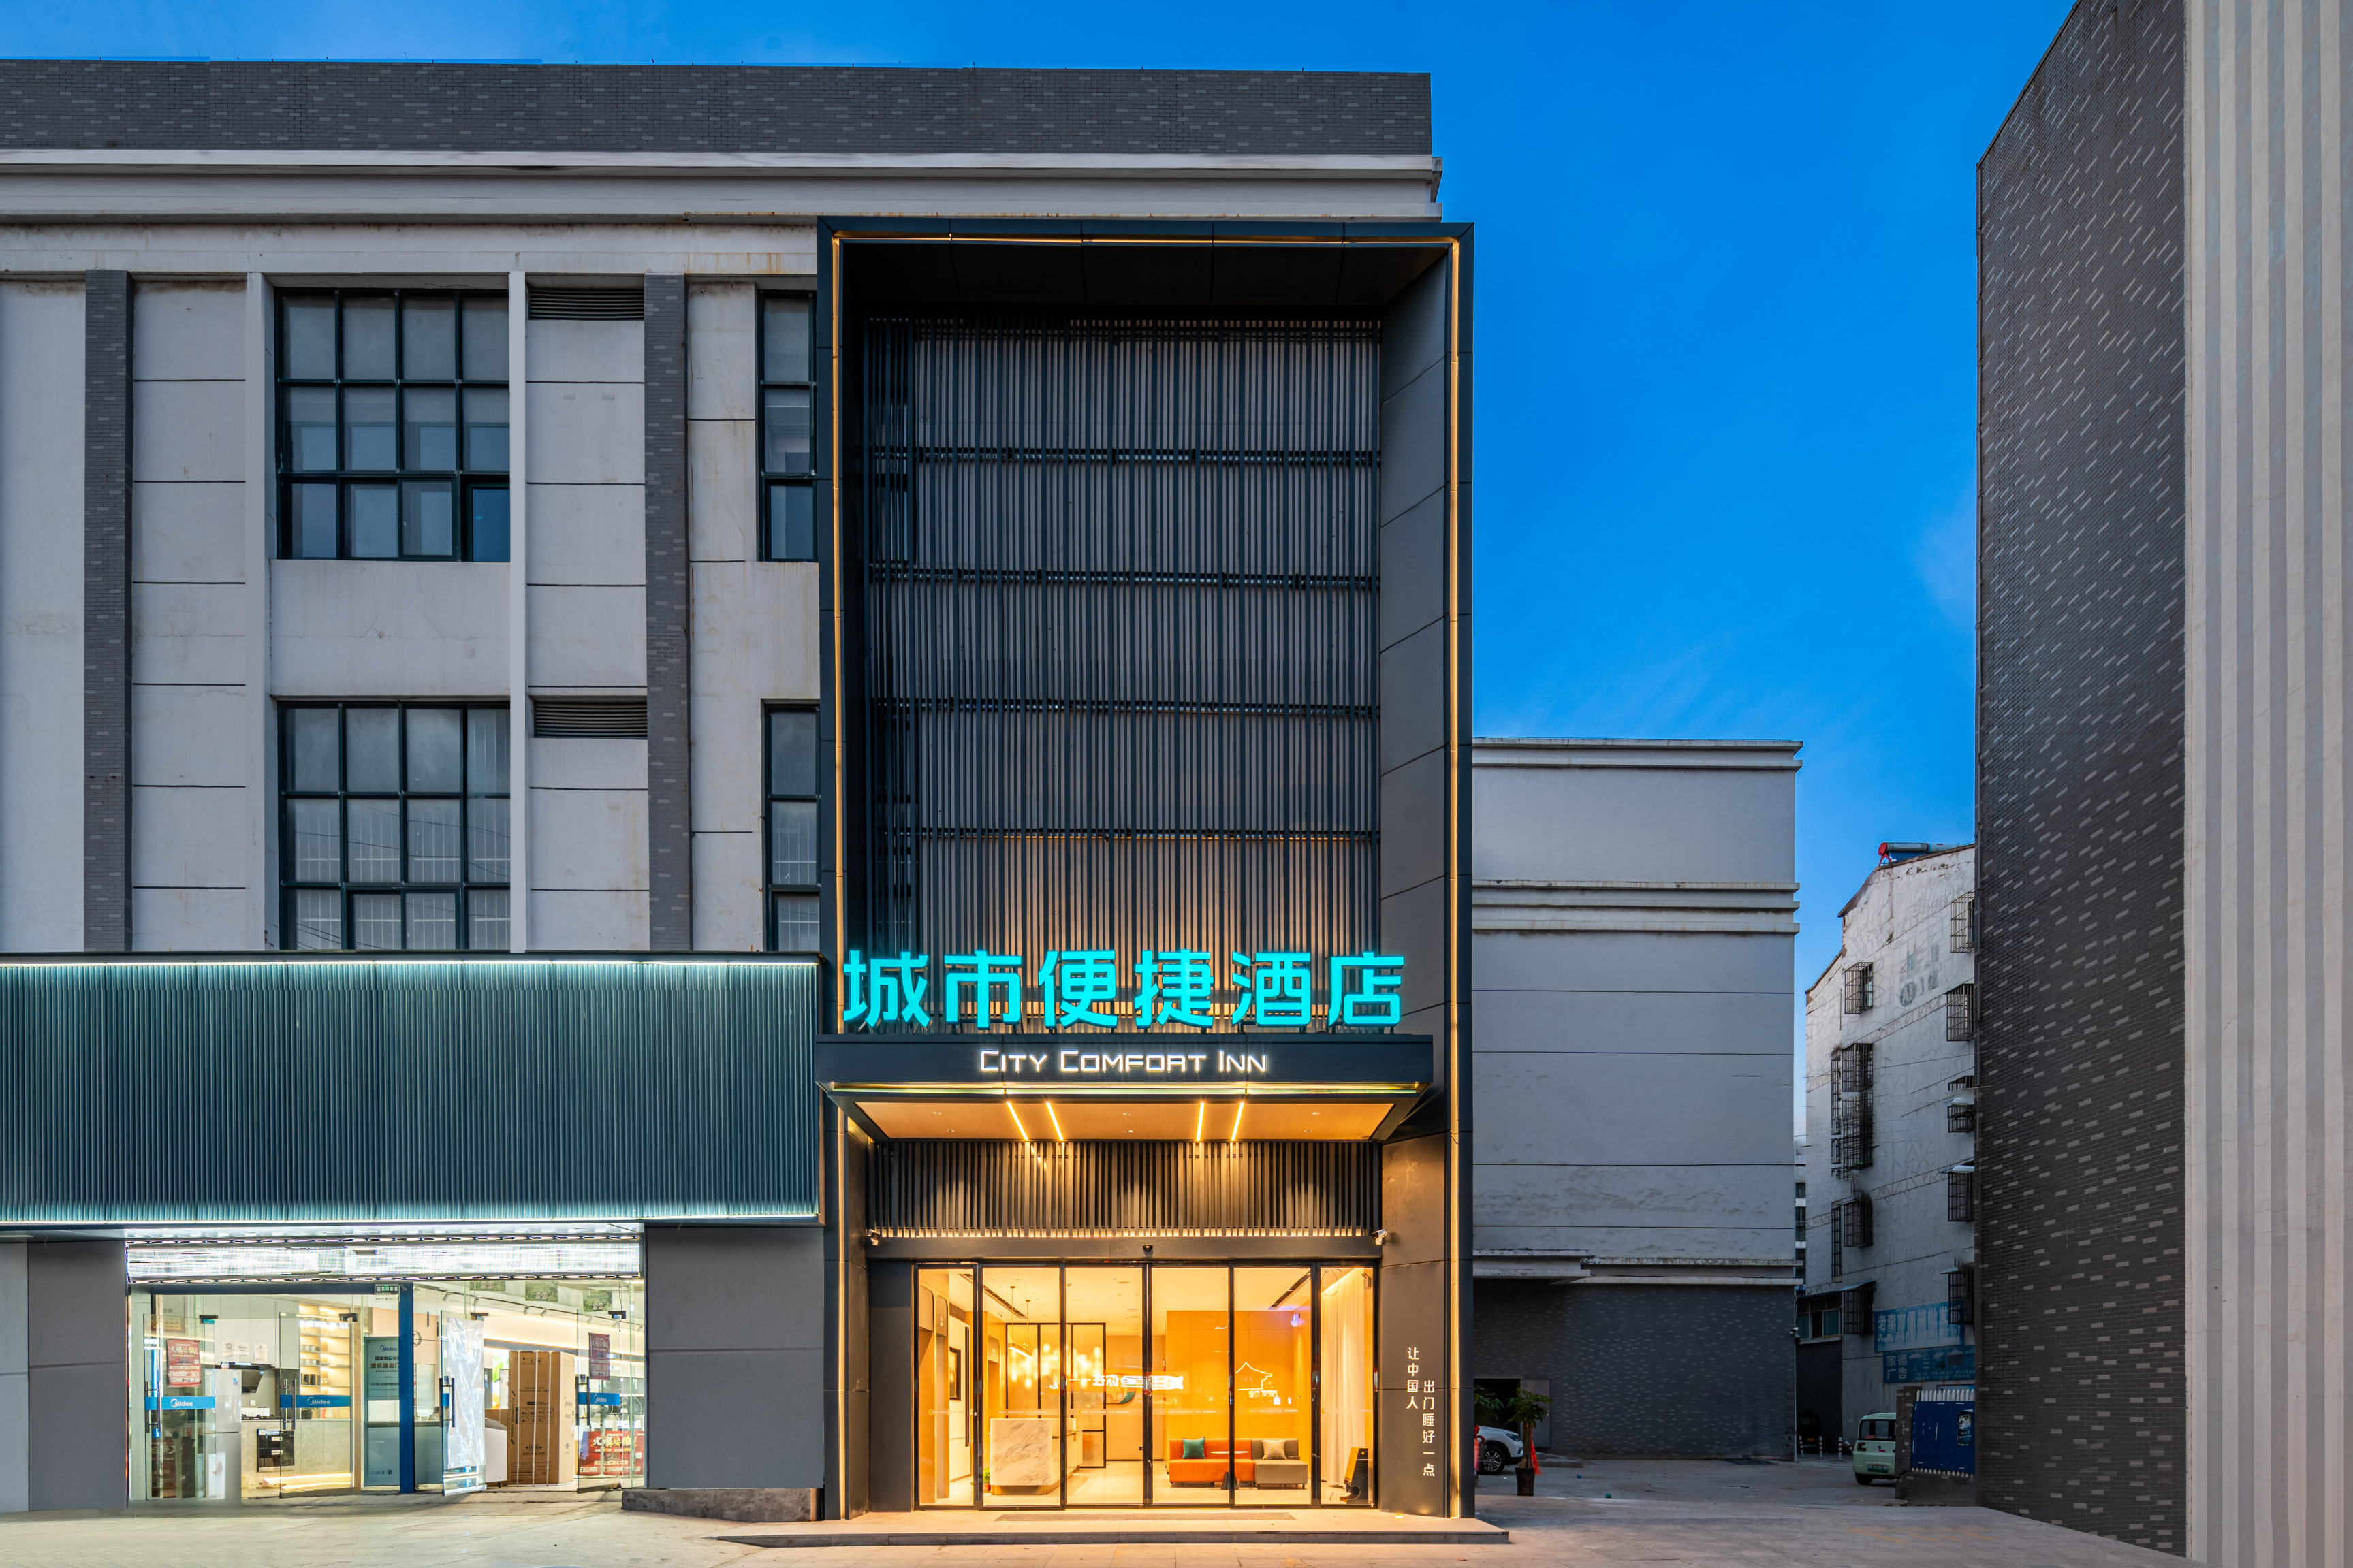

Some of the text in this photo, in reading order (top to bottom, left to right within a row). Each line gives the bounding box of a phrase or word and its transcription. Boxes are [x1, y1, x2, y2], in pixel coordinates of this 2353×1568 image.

[842, 949, 1406, 1030] 城市便捷酒店
[980, 1050, 1268, 1073] CITY COMFORT INN
[1406, 1347, 1419, 1409] 让中国人
[170, 1398, 193, 1408] Midea
[307, 1396, 330, 1406] Midea
[593, 1394, 607, 1403] Midea
[1422, 1379, 1436, 1477] 出门睡好一点
